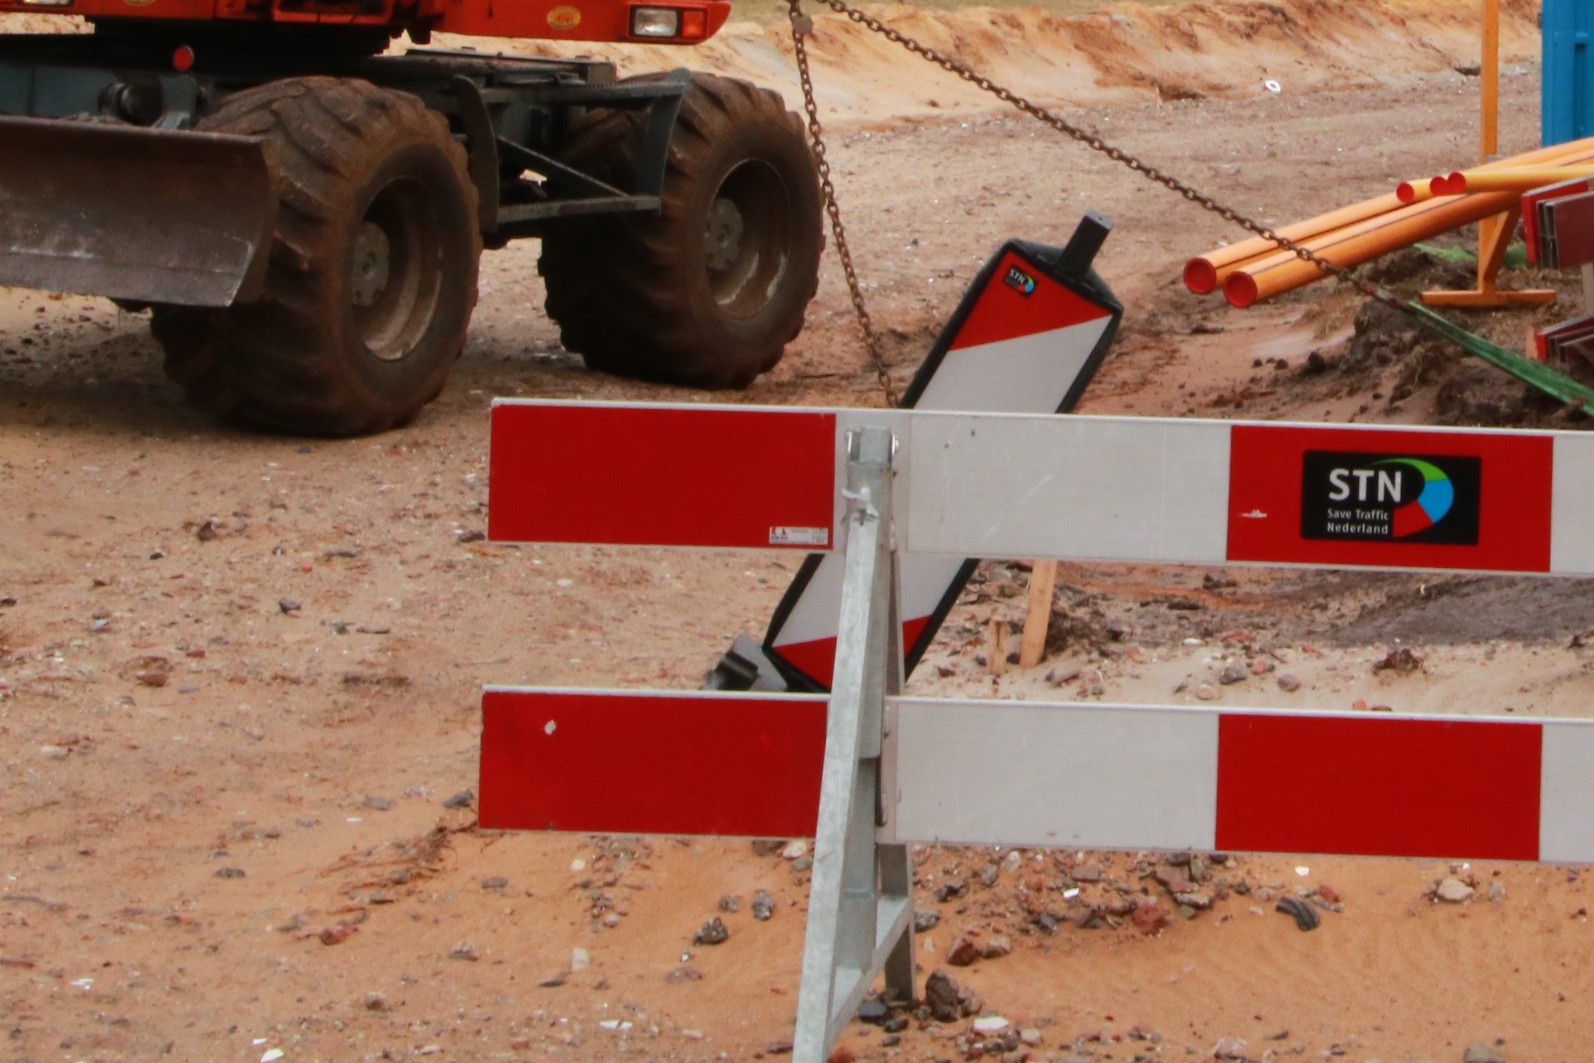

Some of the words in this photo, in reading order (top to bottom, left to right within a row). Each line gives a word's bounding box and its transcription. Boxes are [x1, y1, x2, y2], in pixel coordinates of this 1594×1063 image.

[1329, 468, 1402, 503] STN
[1327, 508, 1352, 519] Save
[1356, 509, 1389, 521] Traffic
[1327, 522, 1389, 534] Nederland
